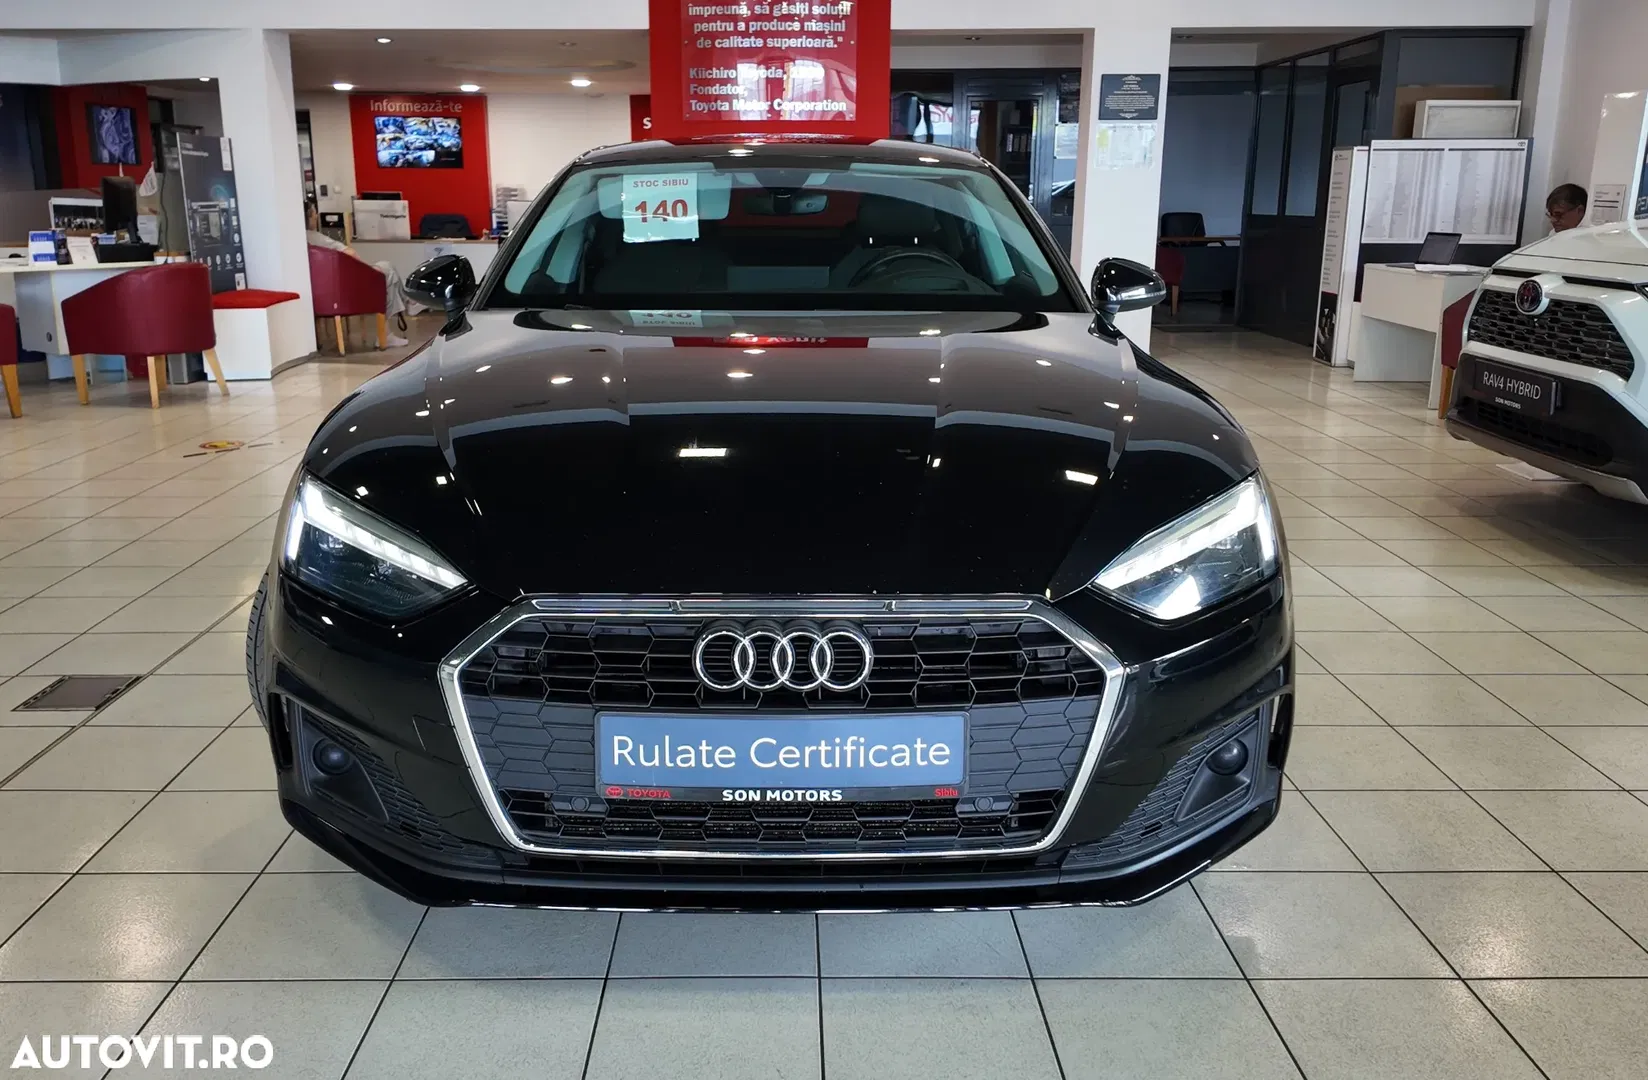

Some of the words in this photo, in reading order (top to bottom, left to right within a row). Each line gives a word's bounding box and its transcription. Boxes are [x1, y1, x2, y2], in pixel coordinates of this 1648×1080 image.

[688, 2, 751, 17] împreună,
[754, 2, 770, 15] să
[694, 20, 734, 34] pentru
[737, 22, 746, 31] a
[749, 19, 801, 34] produce
[697, 36, 712, 48] de
[715, 36, 764, 48] calitate
[690, 67, 737, 78] Kiichiro
[690, 84, 748, 96] Fondator,
[690, 100, 730, 113] Toyota
[733, 100, 770, 112] Motor
[773, 98, 847, 113] Corporation
[633, 180, 659, 188] STOC
[662, 178, 689, 187] SIBIU
[635, 199, 688, 223] 140
[1483, 371, 1505, 390] RAV4
[1506, 378, 1542, 400] HYBRID
[1495, 396, 1504, 404] SON
[1504, 400, 1521, 409] MOTORS
[613, 735, 736, 769] Rulate
[750, 735, 951, 769] Certificate
[627, 788, 671, 798] TOYOTA
[722, 789, 761, 801] SON
[766, 789, 843, 801] MOTORS
